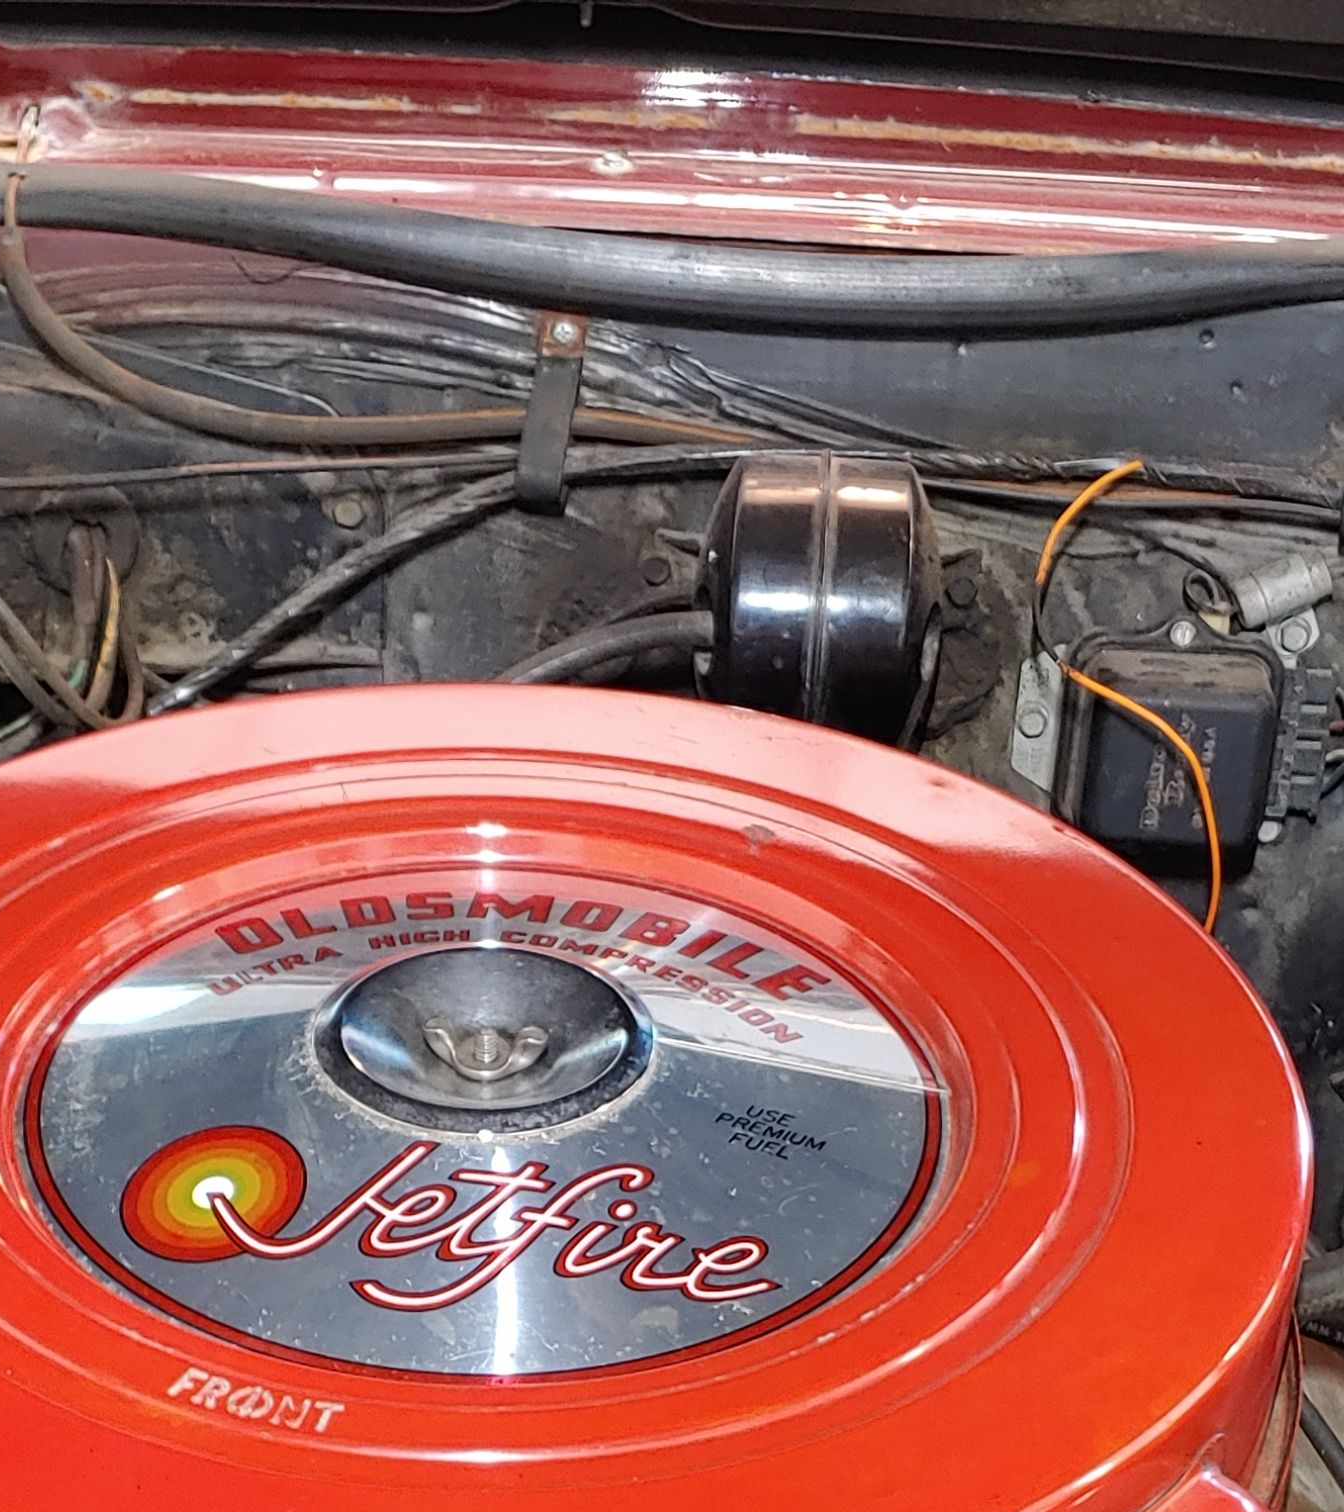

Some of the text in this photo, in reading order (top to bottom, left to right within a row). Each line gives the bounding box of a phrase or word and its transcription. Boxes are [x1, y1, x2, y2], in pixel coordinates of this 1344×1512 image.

[214, 890, 832, 1002] OLDSMOBILE
[206, 927, 807, 1046] ULTRA HIGH COMPRESSION
[714, 1111, 827, 1151] PREMIUM
[728, 1132, 790, 1161] FUEL
[745, 1105, 796, 1128] USE
[208, 1140, 782, 1312] Jetfire
[166, 1366, 346, 1433] FRONT
